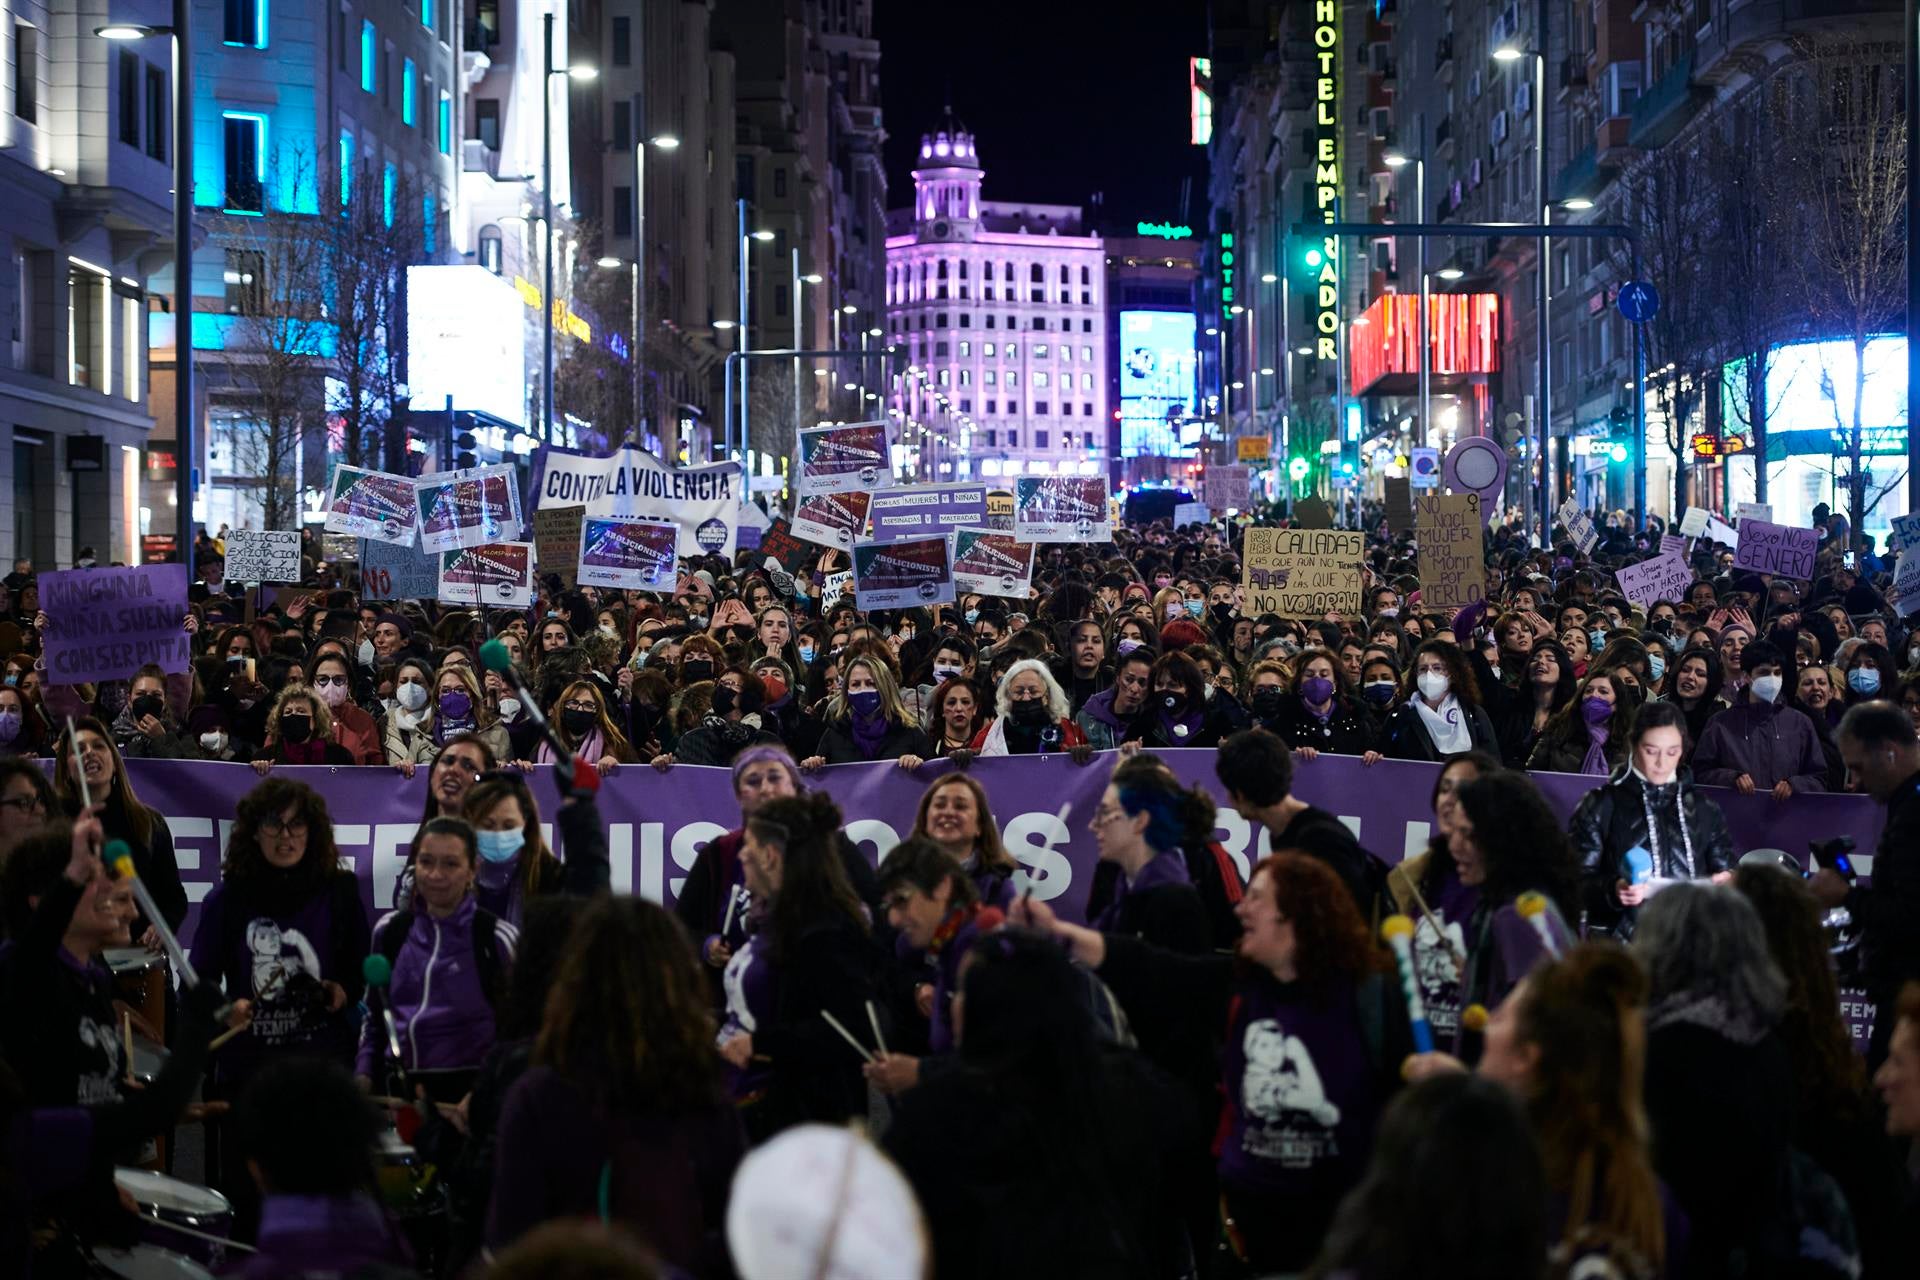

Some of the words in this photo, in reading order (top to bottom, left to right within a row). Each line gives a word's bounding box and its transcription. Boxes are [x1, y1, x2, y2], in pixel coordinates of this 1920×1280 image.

[1315, 0, 1336, 125] HOTEL
[1221, 233, 1233, 319] HOTEL
[606, 467, 626, 495] LA
[632, 467, 732, 500] VIOLENCIA
[904, 494, 938, 504] MUJERES
[1412, 495, 1440, 514] NO
[883, 516, 921, 525] ASESINADAS
[1275, 531, 1360, 555] CALLADAS
[1418, 527, 1472, 543] MUJER
[1741, 520, 1779, 544] Sexo
[1782, 528, 1801, 548] NO
[230, 557, 271, 566] SEXUAL
[874, 554, 941, 573] ABOLICIONISTA
[973, 540, 1024, 570] ABOLICIONISTA
[1249, 557, 1267, 565] LAS
[1272, 558, 1292, 567] QUE
[1320, 558, 1334, 567] NO
[1738, 543, 1814, 578] GENERO
[46, 574, 153, 604] NINGUNA
[363, 566, 392, 599] NO
[1249, 573, 1287, 590] ALAS
[1297, 569, 1304, 578] Y
[1313, 572, 1338, 588] QUE
[1342, 572, 1359, 588] YA
[1628, 582, 1655, 600] ESTOY
[1661, 572, 1687, 589] HASTA
[1254, 594, 1276, 612] NO
[50, 606, 114, 641] NIÑA
[117, 599, 184, 634] SUEÑA
